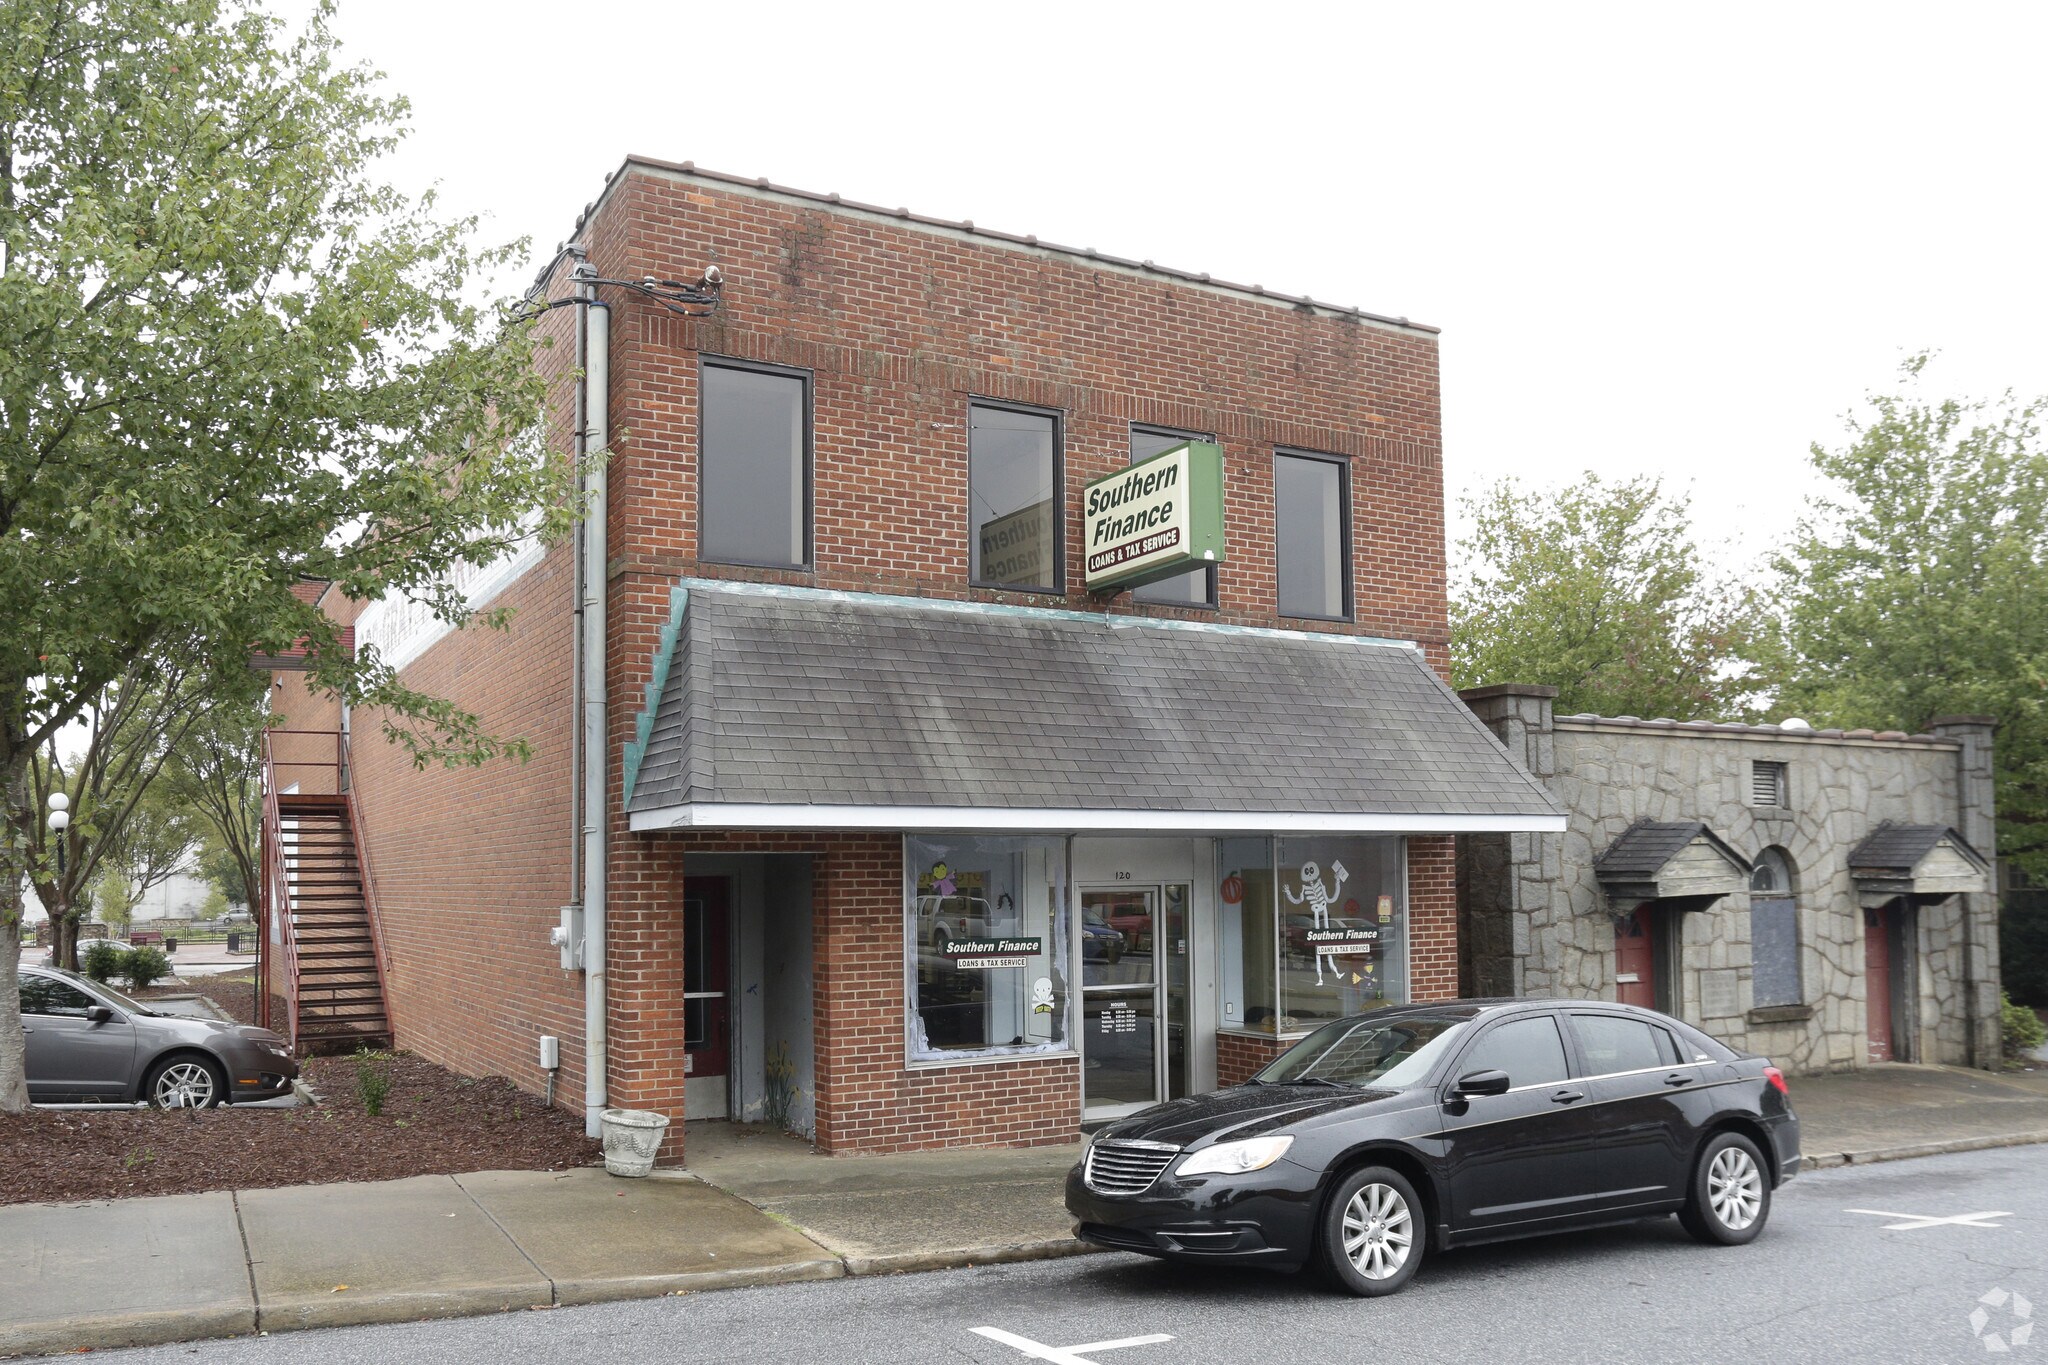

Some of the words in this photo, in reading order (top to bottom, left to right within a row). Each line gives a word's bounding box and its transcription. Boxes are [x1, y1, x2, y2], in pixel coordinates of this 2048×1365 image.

[1087, 463, 1178, 517] Southern
[1093, 501, 1173, 546] Finance
[1091, 550, 1116, 569] LOANS
[1117, 549, 1124, 560] &
[1125, 543, 1140, 558] TAX
[1143, 530, 1177, 553] SERVICE
[1115, 871, 1131, 880] 120
[1306, 930, 1344, 941] Southern
[1346, 929, 1378, 939] Finance
[946, 941, 995, 953] Southern
[998, 940, 1039, 951] Finance
[1000, 958, 1025, 966] SERVICE
